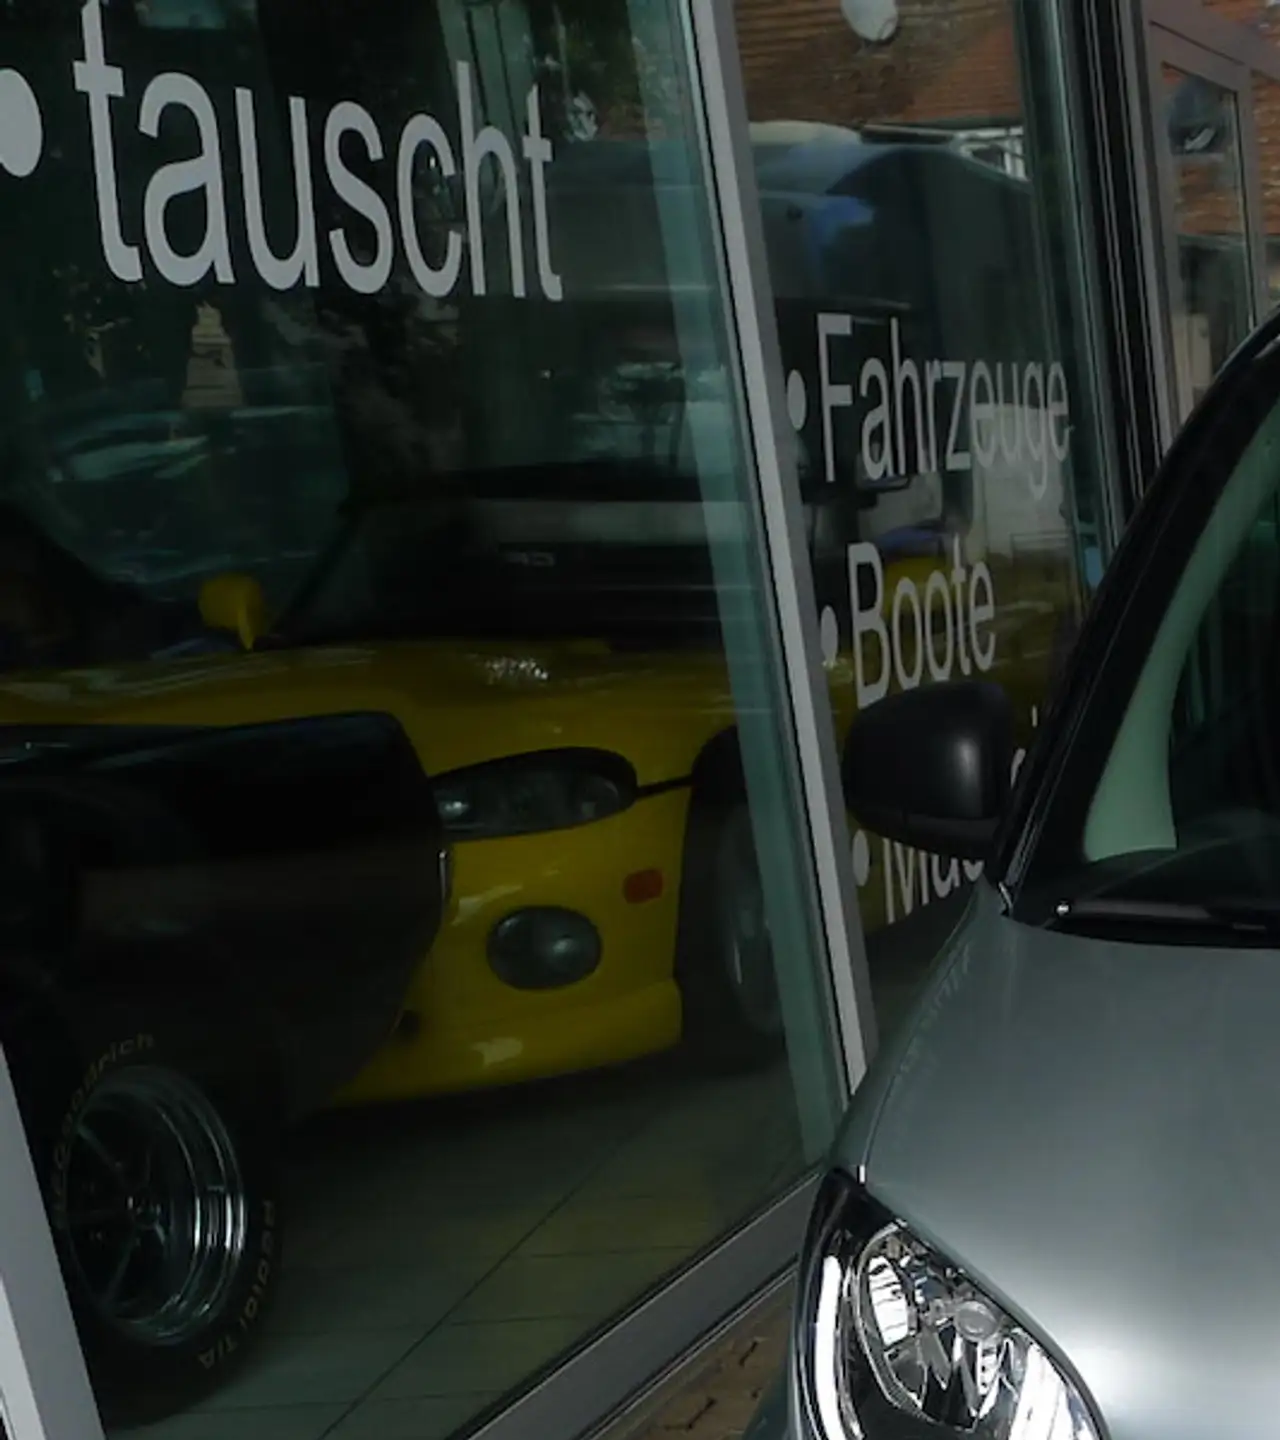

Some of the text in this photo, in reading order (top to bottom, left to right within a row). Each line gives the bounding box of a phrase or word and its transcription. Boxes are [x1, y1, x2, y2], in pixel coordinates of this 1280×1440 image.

[73, 0, 562, 300] tauscht
[816, 313, 1072, 496] Fahrzeuge
[846, 531, 997, 708] Boote
